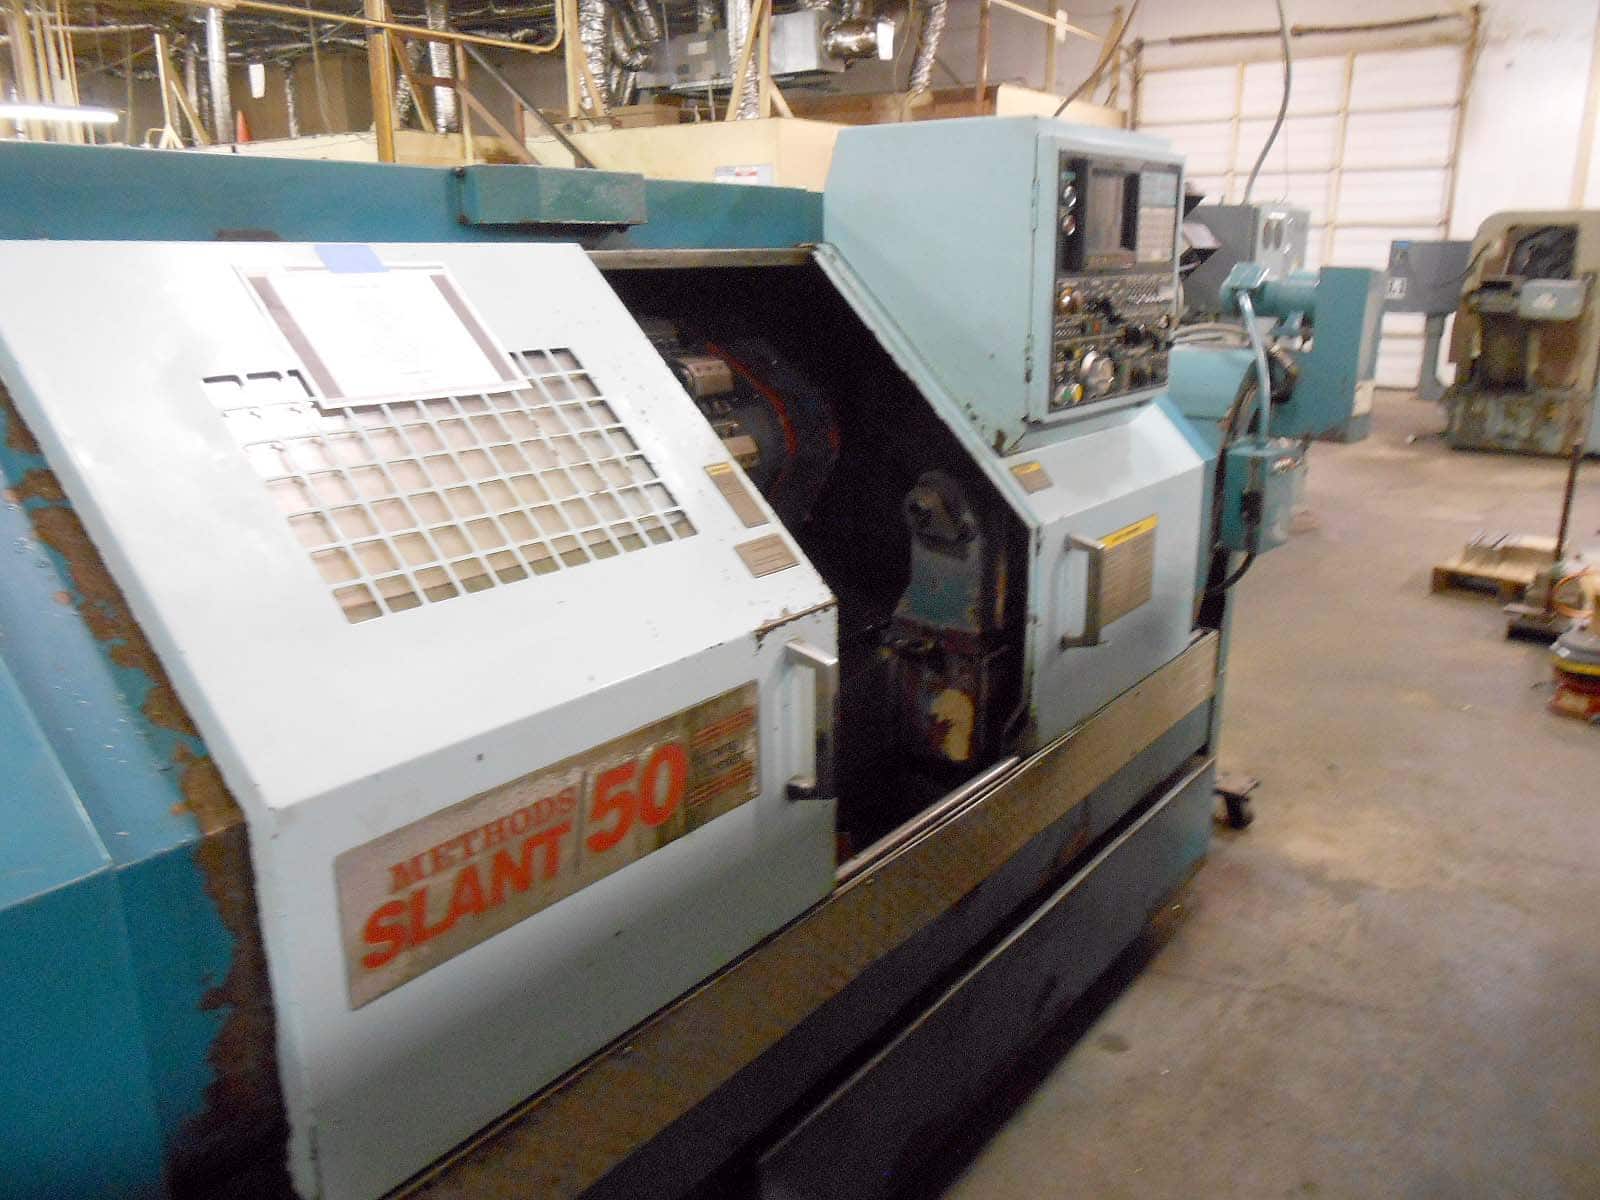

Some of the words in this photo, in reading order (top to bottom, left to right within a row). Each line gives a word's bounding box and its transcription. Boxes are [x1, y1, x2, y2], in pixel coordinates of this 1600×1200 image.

[361, 822, 571, 970] SLANT
[587, 743, 688, 853] 50
[390, 786, 579, 894] METHODS
